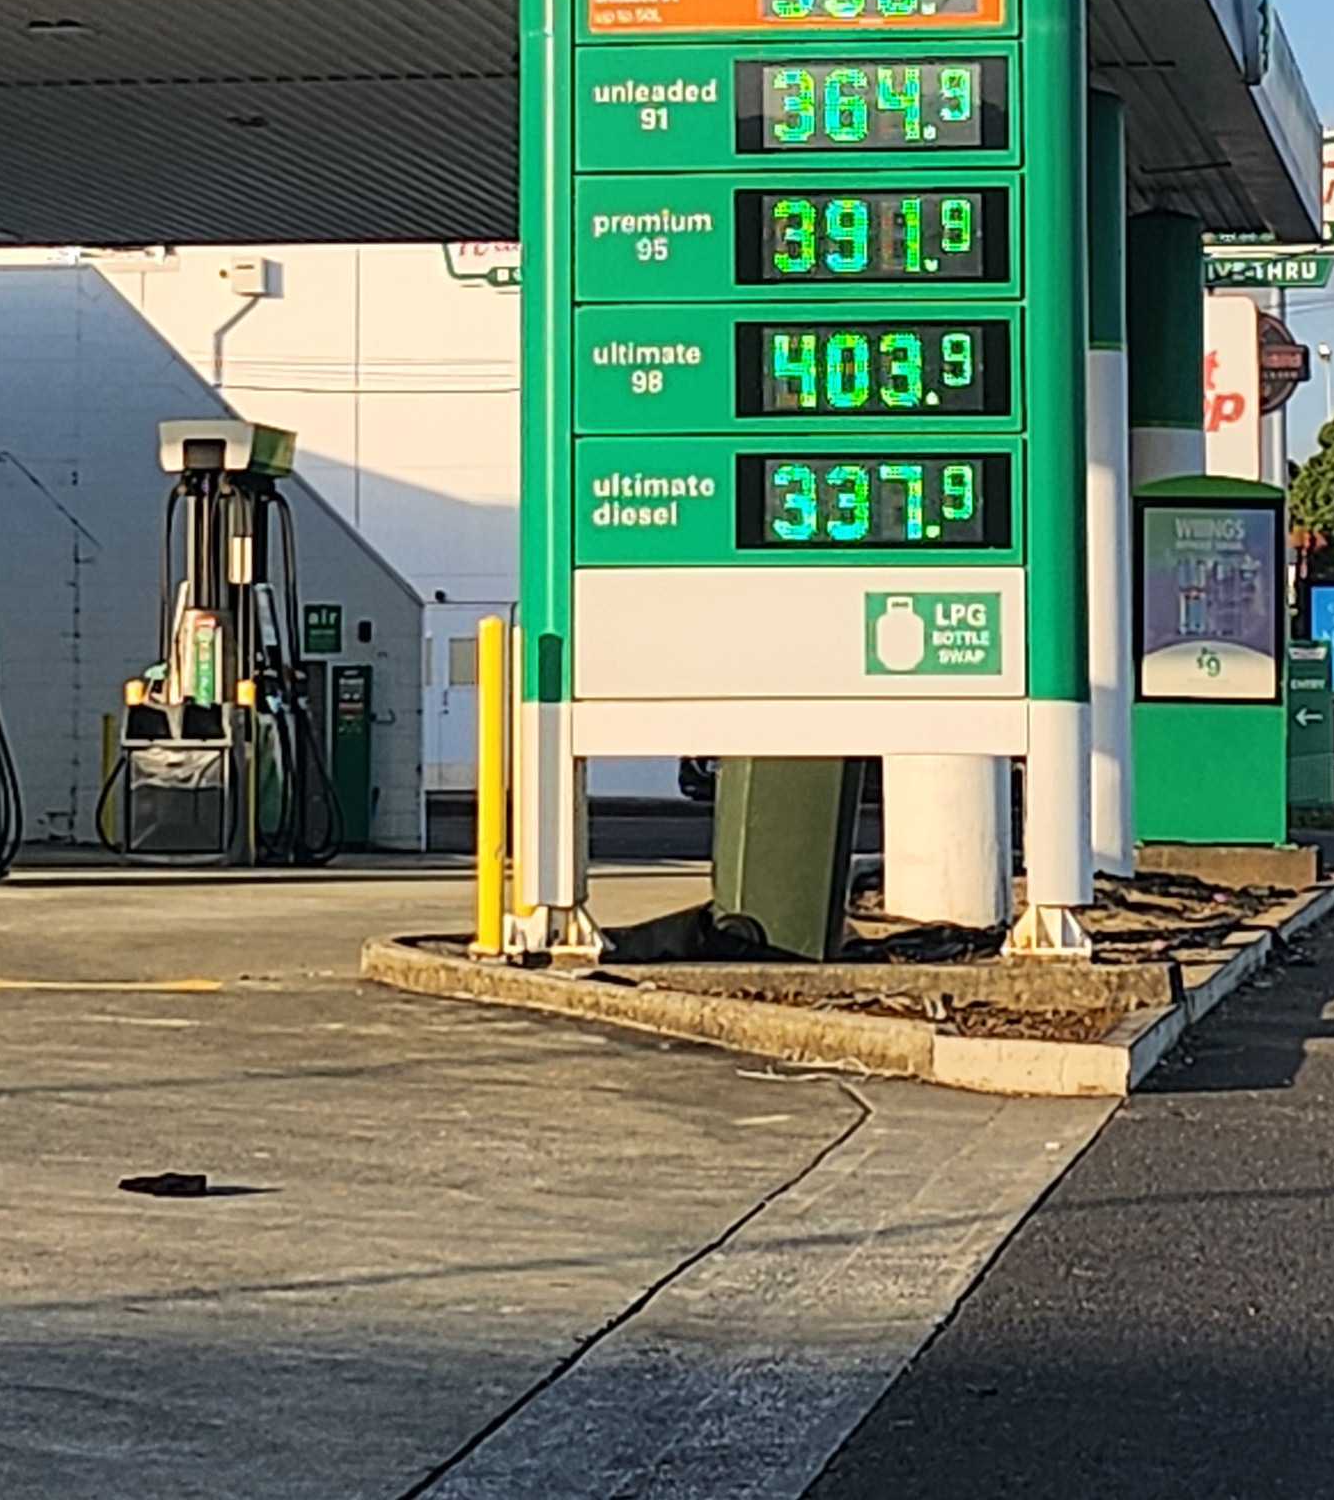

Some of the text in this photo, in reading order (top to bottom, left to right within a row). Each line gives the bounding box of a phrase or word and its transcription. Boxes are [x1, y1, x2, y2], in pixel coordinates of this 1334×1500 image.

[593, 77, 718, 104] unleaded
[772, 67, 972, 143] 364.9
[639, 108, 670, 132] 91
[592, 209, 713, 238] premium
[772, 197, 972, 275] 391.9
[635, 238, 669, 262] 95
[1207, 260, 1317, 281] IVE-THRU
[592, 342, 702, 367] ultimate
[631, 369, 664, 395] 98
[772, 332, 973, 409] 403.9
[592, 473, 716, 498] ultimate
[592, 500, 679, 528] diesel
[772, 464, 974, 541] 337.9
[308, 608, 338, 626] air
[934, 602, 988, 628] LPG
[931, 629, 990, 647] BOTTLE
[937, 648, 986, 666] SWAP
